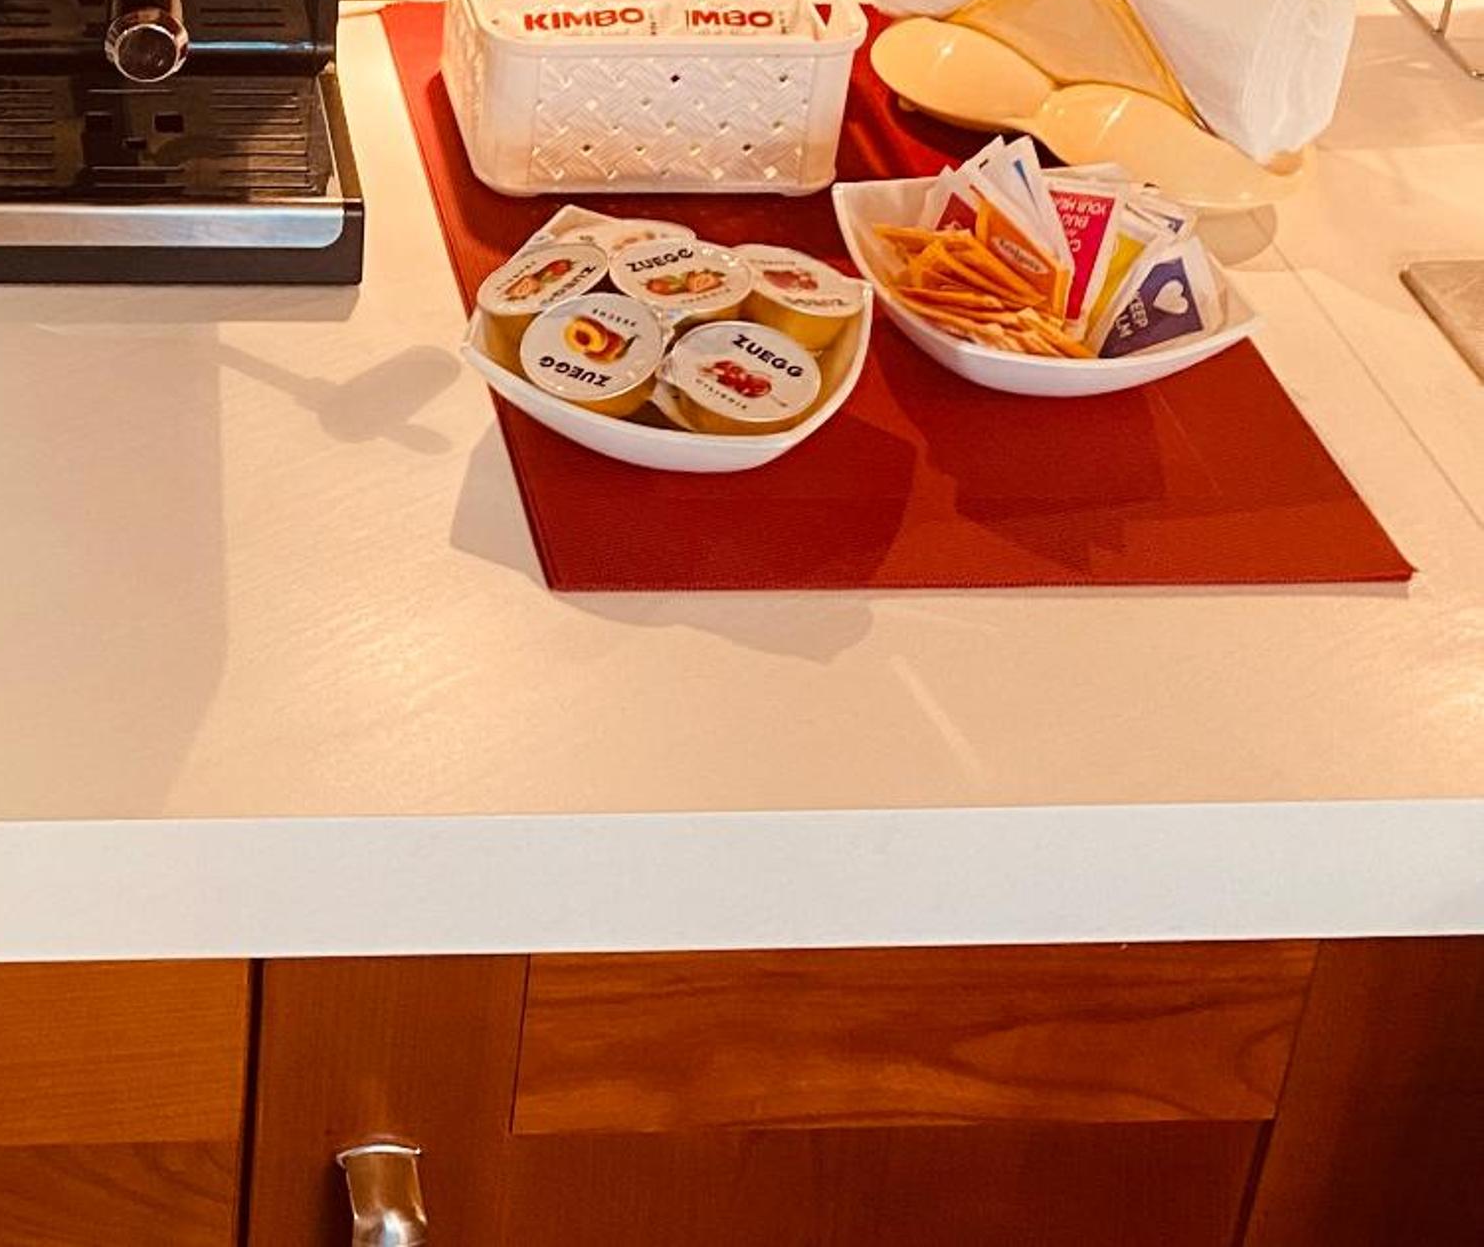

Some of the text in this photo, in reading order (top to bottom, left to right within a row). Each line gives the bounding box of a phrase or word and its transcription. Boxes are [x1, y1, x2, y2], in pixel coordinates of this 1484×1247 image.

[523, 7, 645, 31] KIMBO
[625, 248, 694, 272] ZUEGG
[732, 334, 805, 378] ZUEGG
[539, 356, 612, 387] ZUEGG
